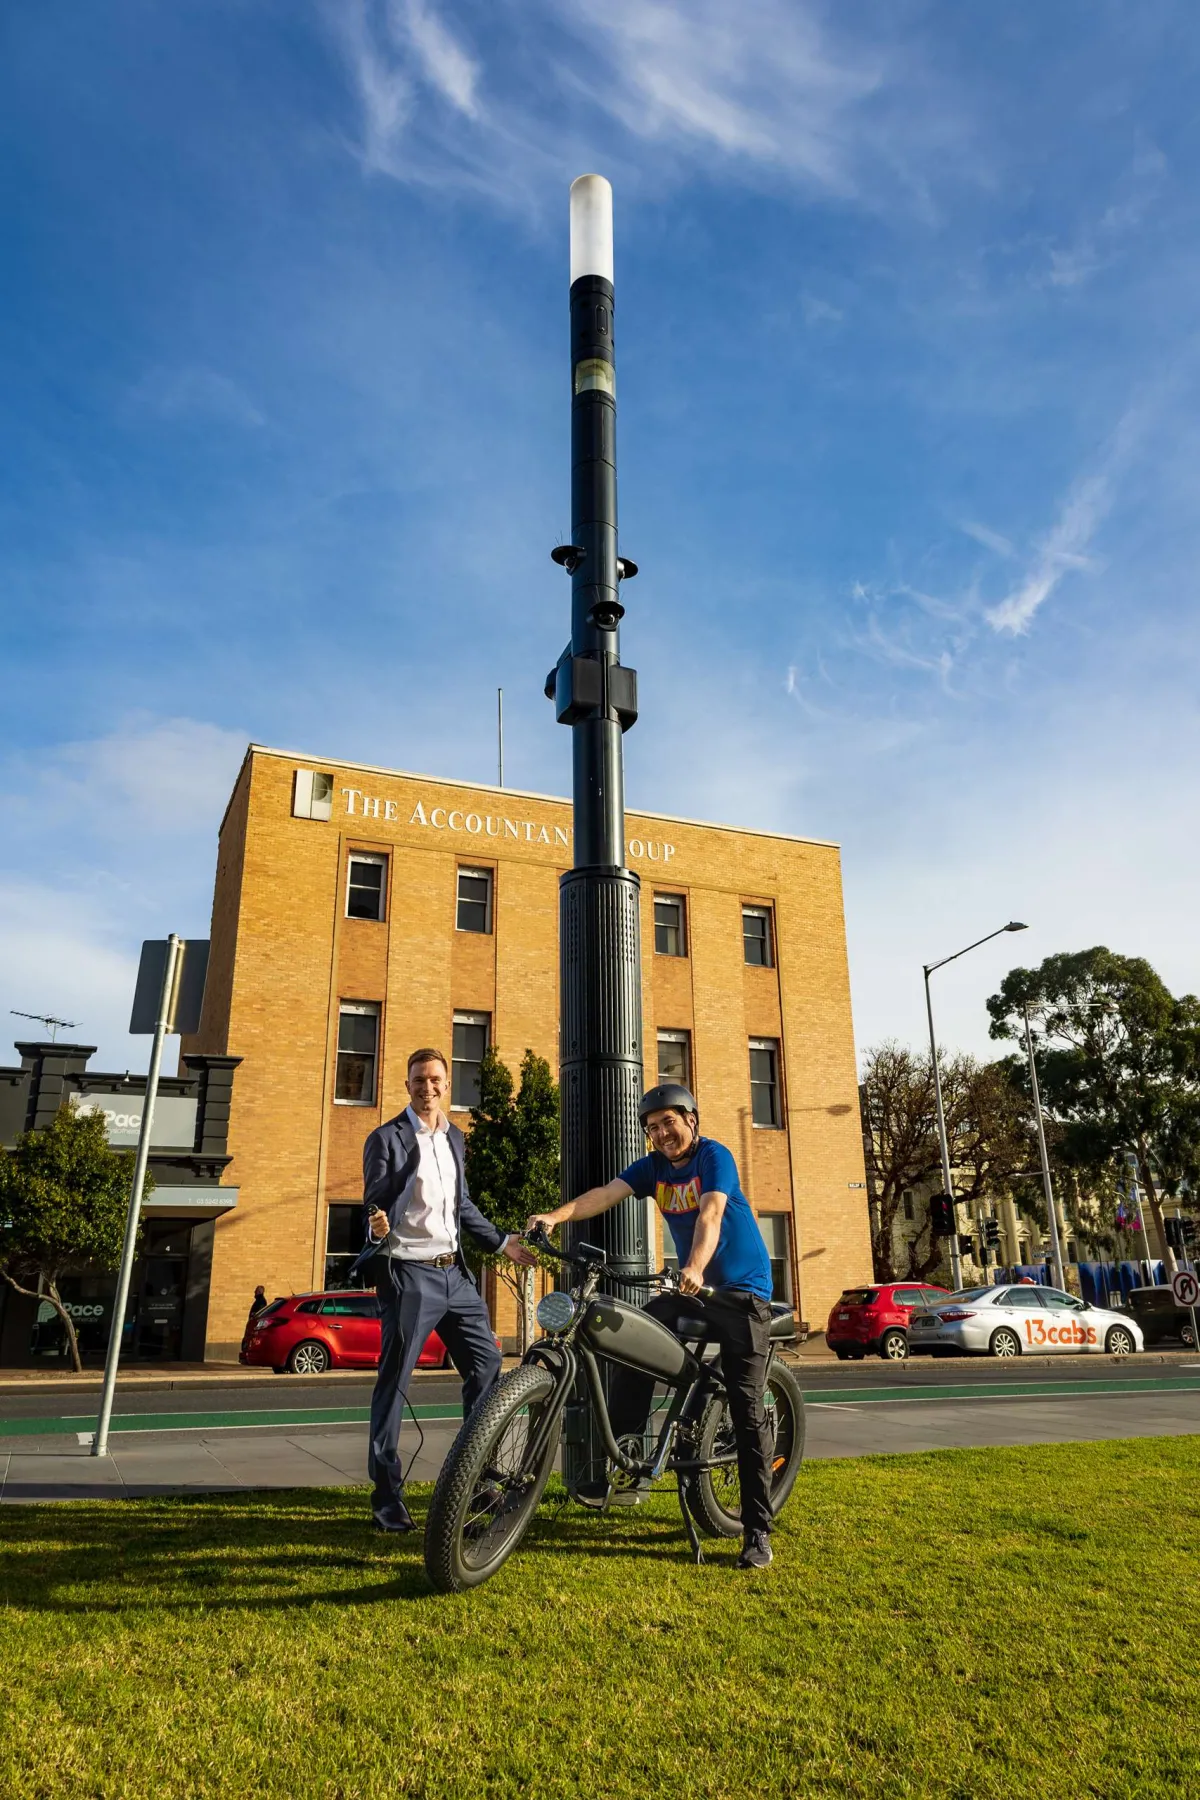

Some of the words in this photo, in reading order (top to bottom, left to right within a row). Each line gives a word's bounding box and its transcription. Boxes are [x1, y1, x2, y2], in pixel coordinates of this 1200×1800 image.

[341, 788, 398, 821] THE
[409, 800, 573, 846] ACCOUNTAN
[625, 839, 675, 862] OUP
[103, 1110, 155, 1128] Pac
[61, 1302, 104, 1317] Pace
[1025, 1319, 1097, 1344] 13cabs
